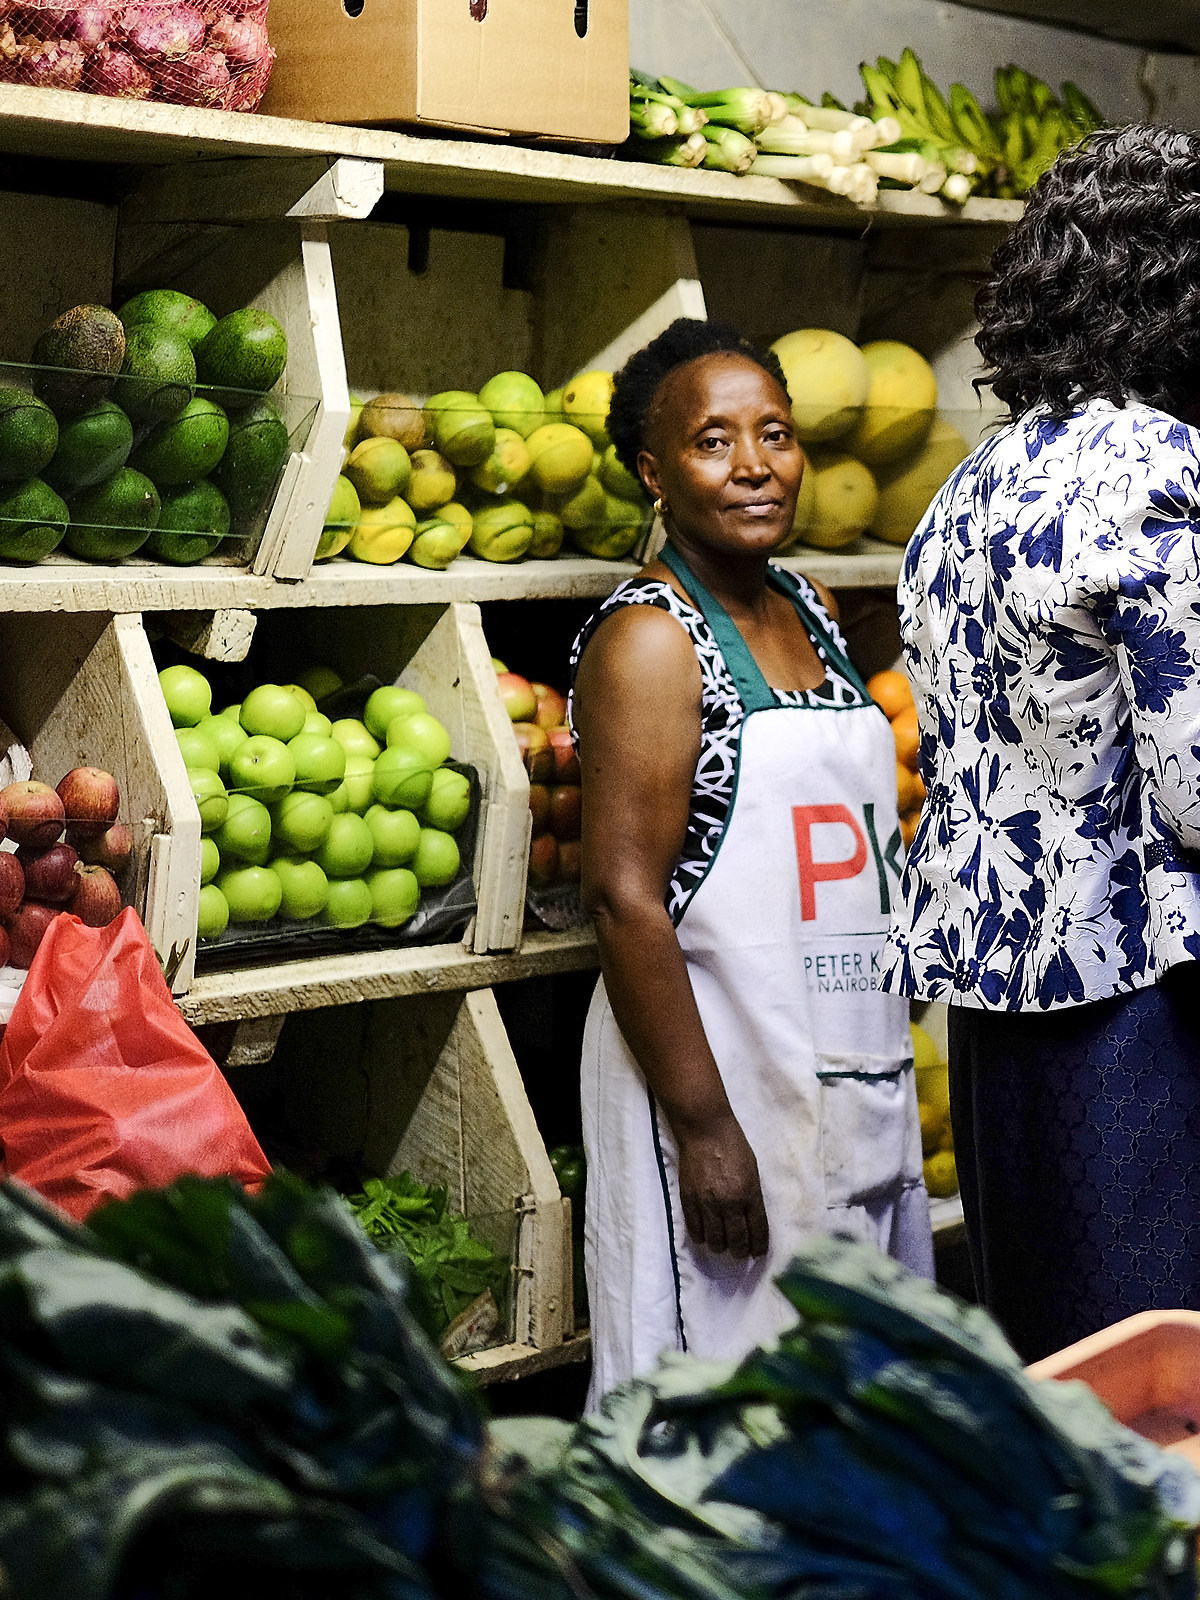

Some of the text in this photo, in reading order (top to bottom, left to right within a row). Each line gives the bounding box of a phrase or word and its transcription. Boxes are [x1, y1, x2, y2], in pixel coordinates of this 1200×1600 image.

[791, 803, 903, 921] PK
[804, 950, 881, 977] PETER K
[818, 977, 878, 993] NAIROB
